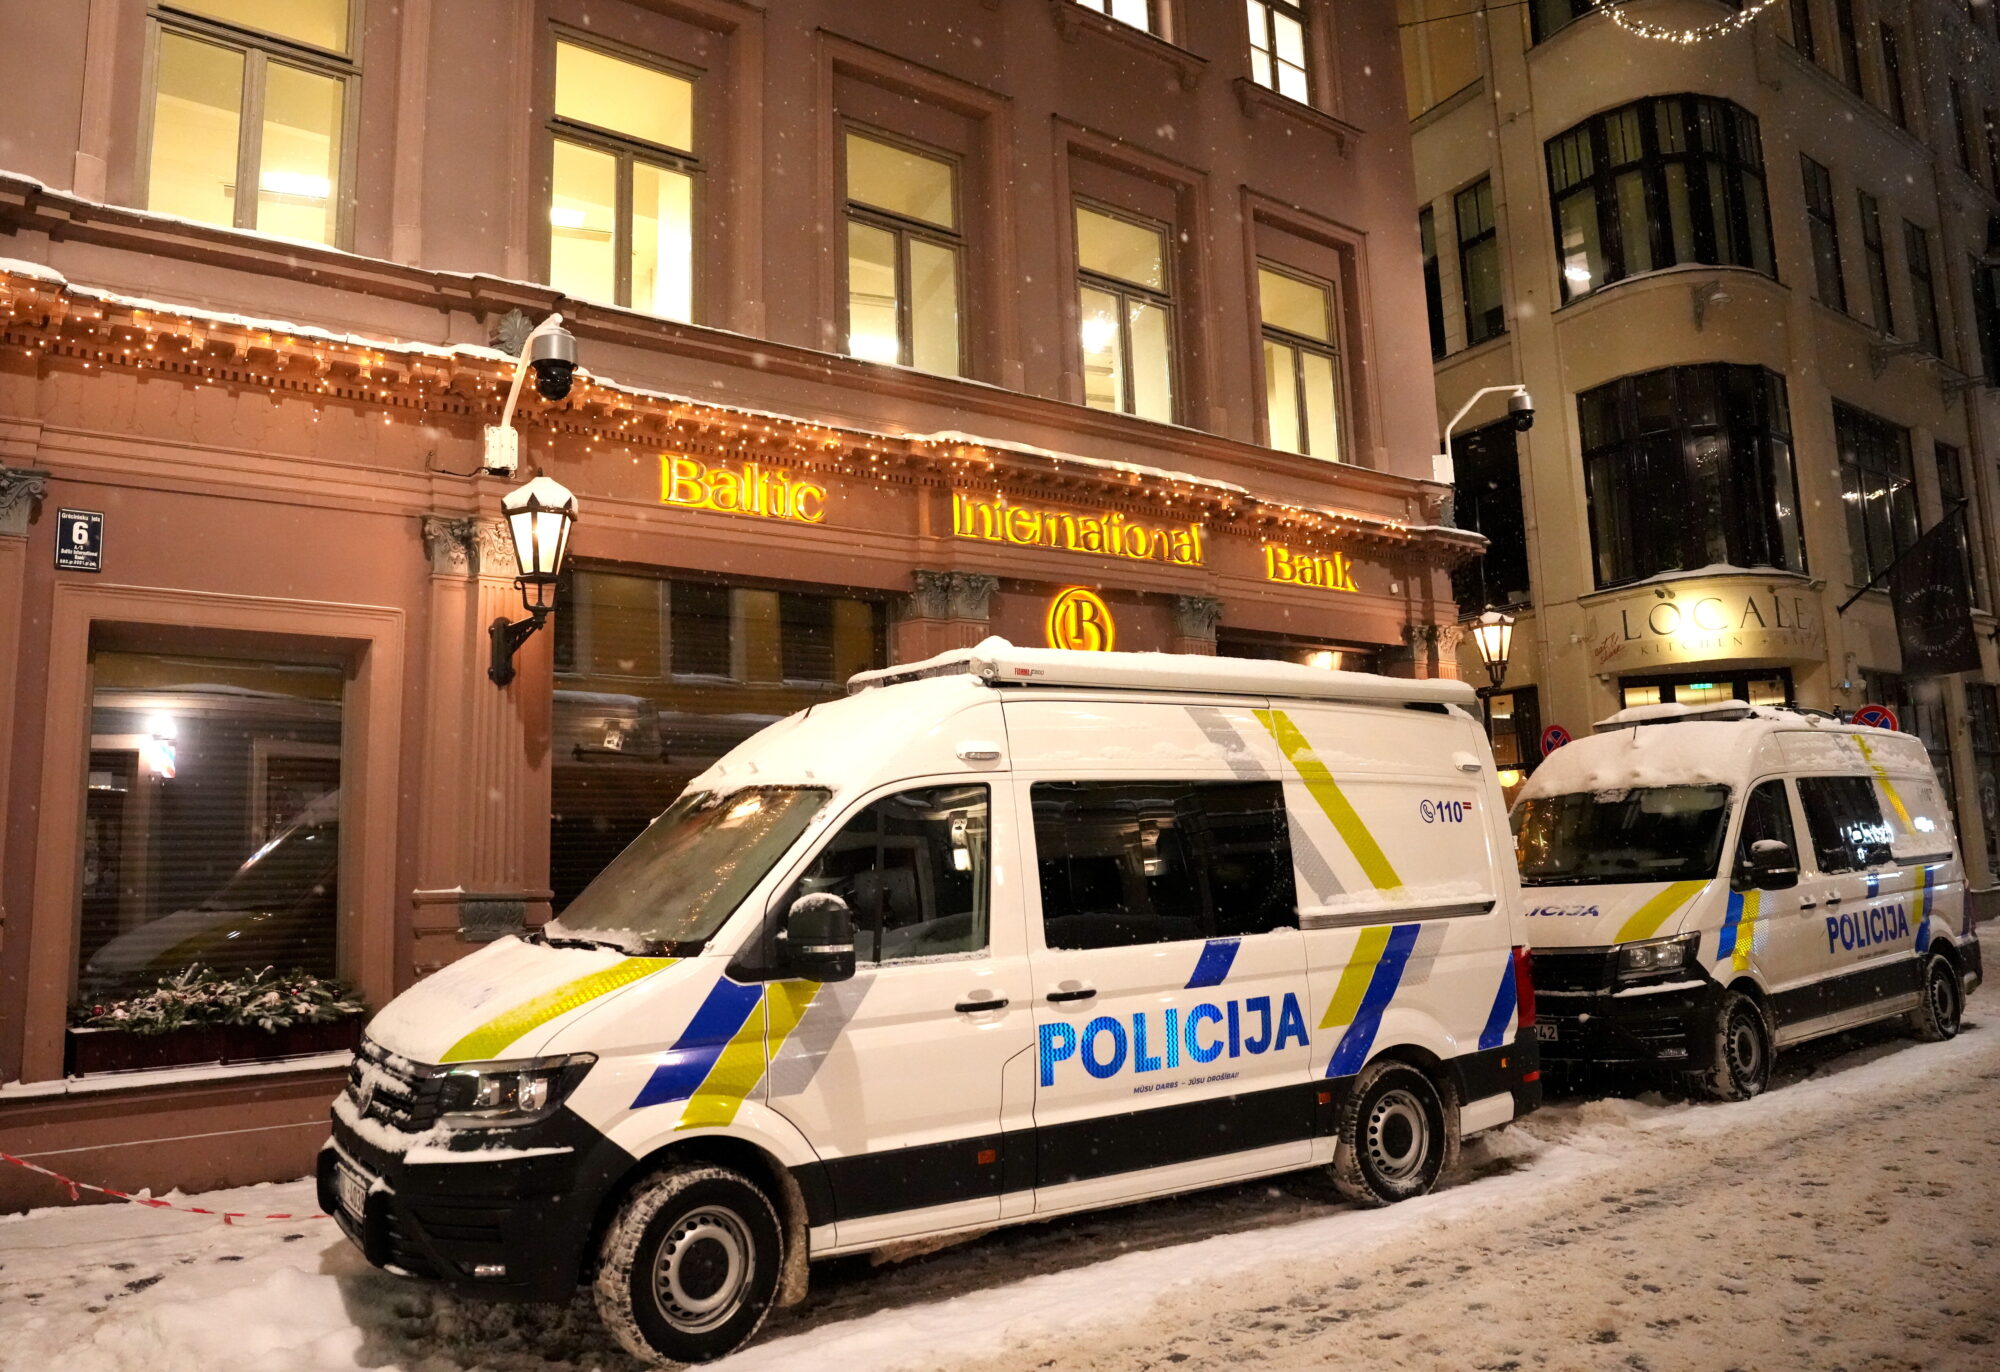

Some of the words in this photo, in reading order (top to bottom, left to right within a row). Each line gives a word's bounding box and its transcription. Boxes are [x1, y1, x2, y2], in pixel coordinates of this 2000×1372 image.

[72, 521, 89, 545] 6
[660, 453, 827, 524] Baltic
[952, 493, 1206, 567] International
[1265, 544, 1359, 592] Bank
[1621, 595, 1808, 641] LOCALE
[1436, 800, 1463, 822] 110
[1524, 904, 1599, 917] ICIJA
[1826, 903, 1910, 955] POLICIJA
[1039, 992, 1310, 1088] POLICIJA
[1155, 1081, 1179, 1091] DARBS
